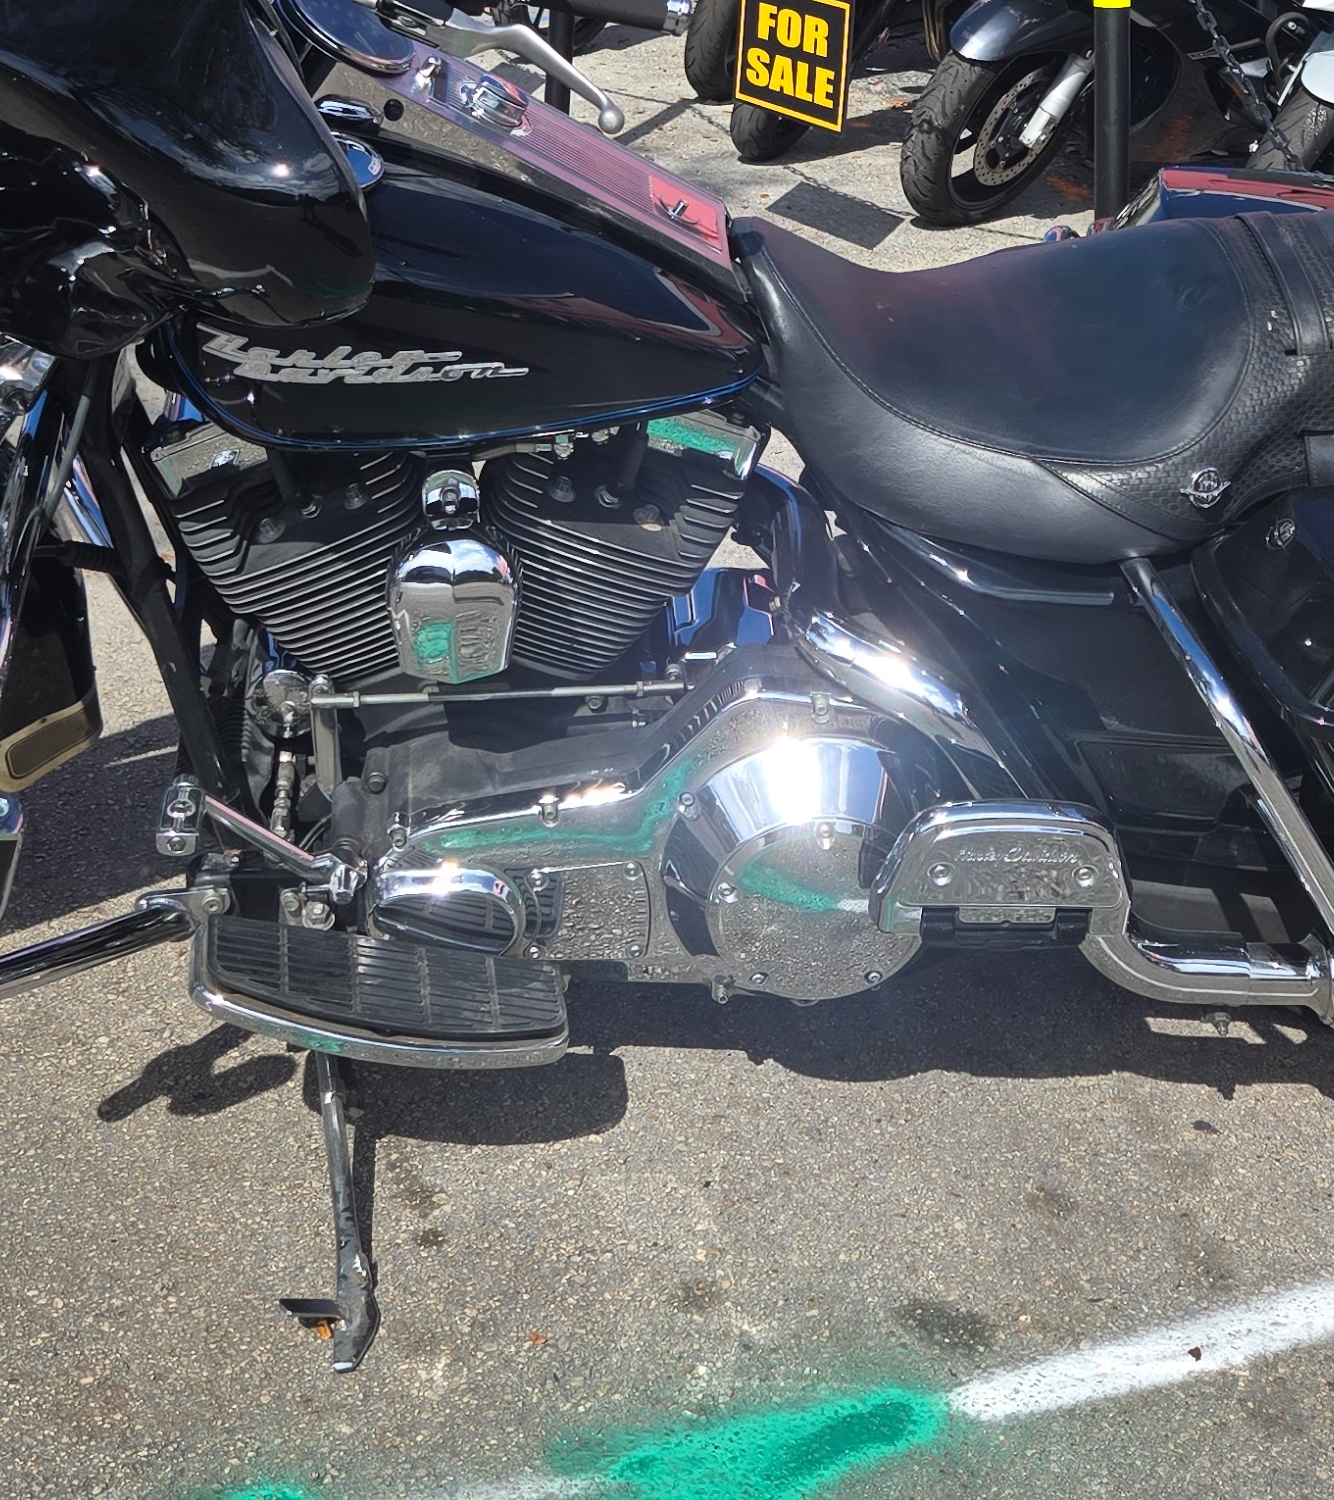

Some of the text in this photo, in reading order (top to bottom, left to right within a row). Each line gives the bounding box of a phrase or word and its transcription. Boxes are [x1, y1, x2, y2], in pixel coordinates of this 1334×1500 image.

[757, 2, 829, 57] FOR
[746, 47, 835, 109] SALE
[196, 322, 463, 369] Harley
[233, 361, 529, 384] Davidson
